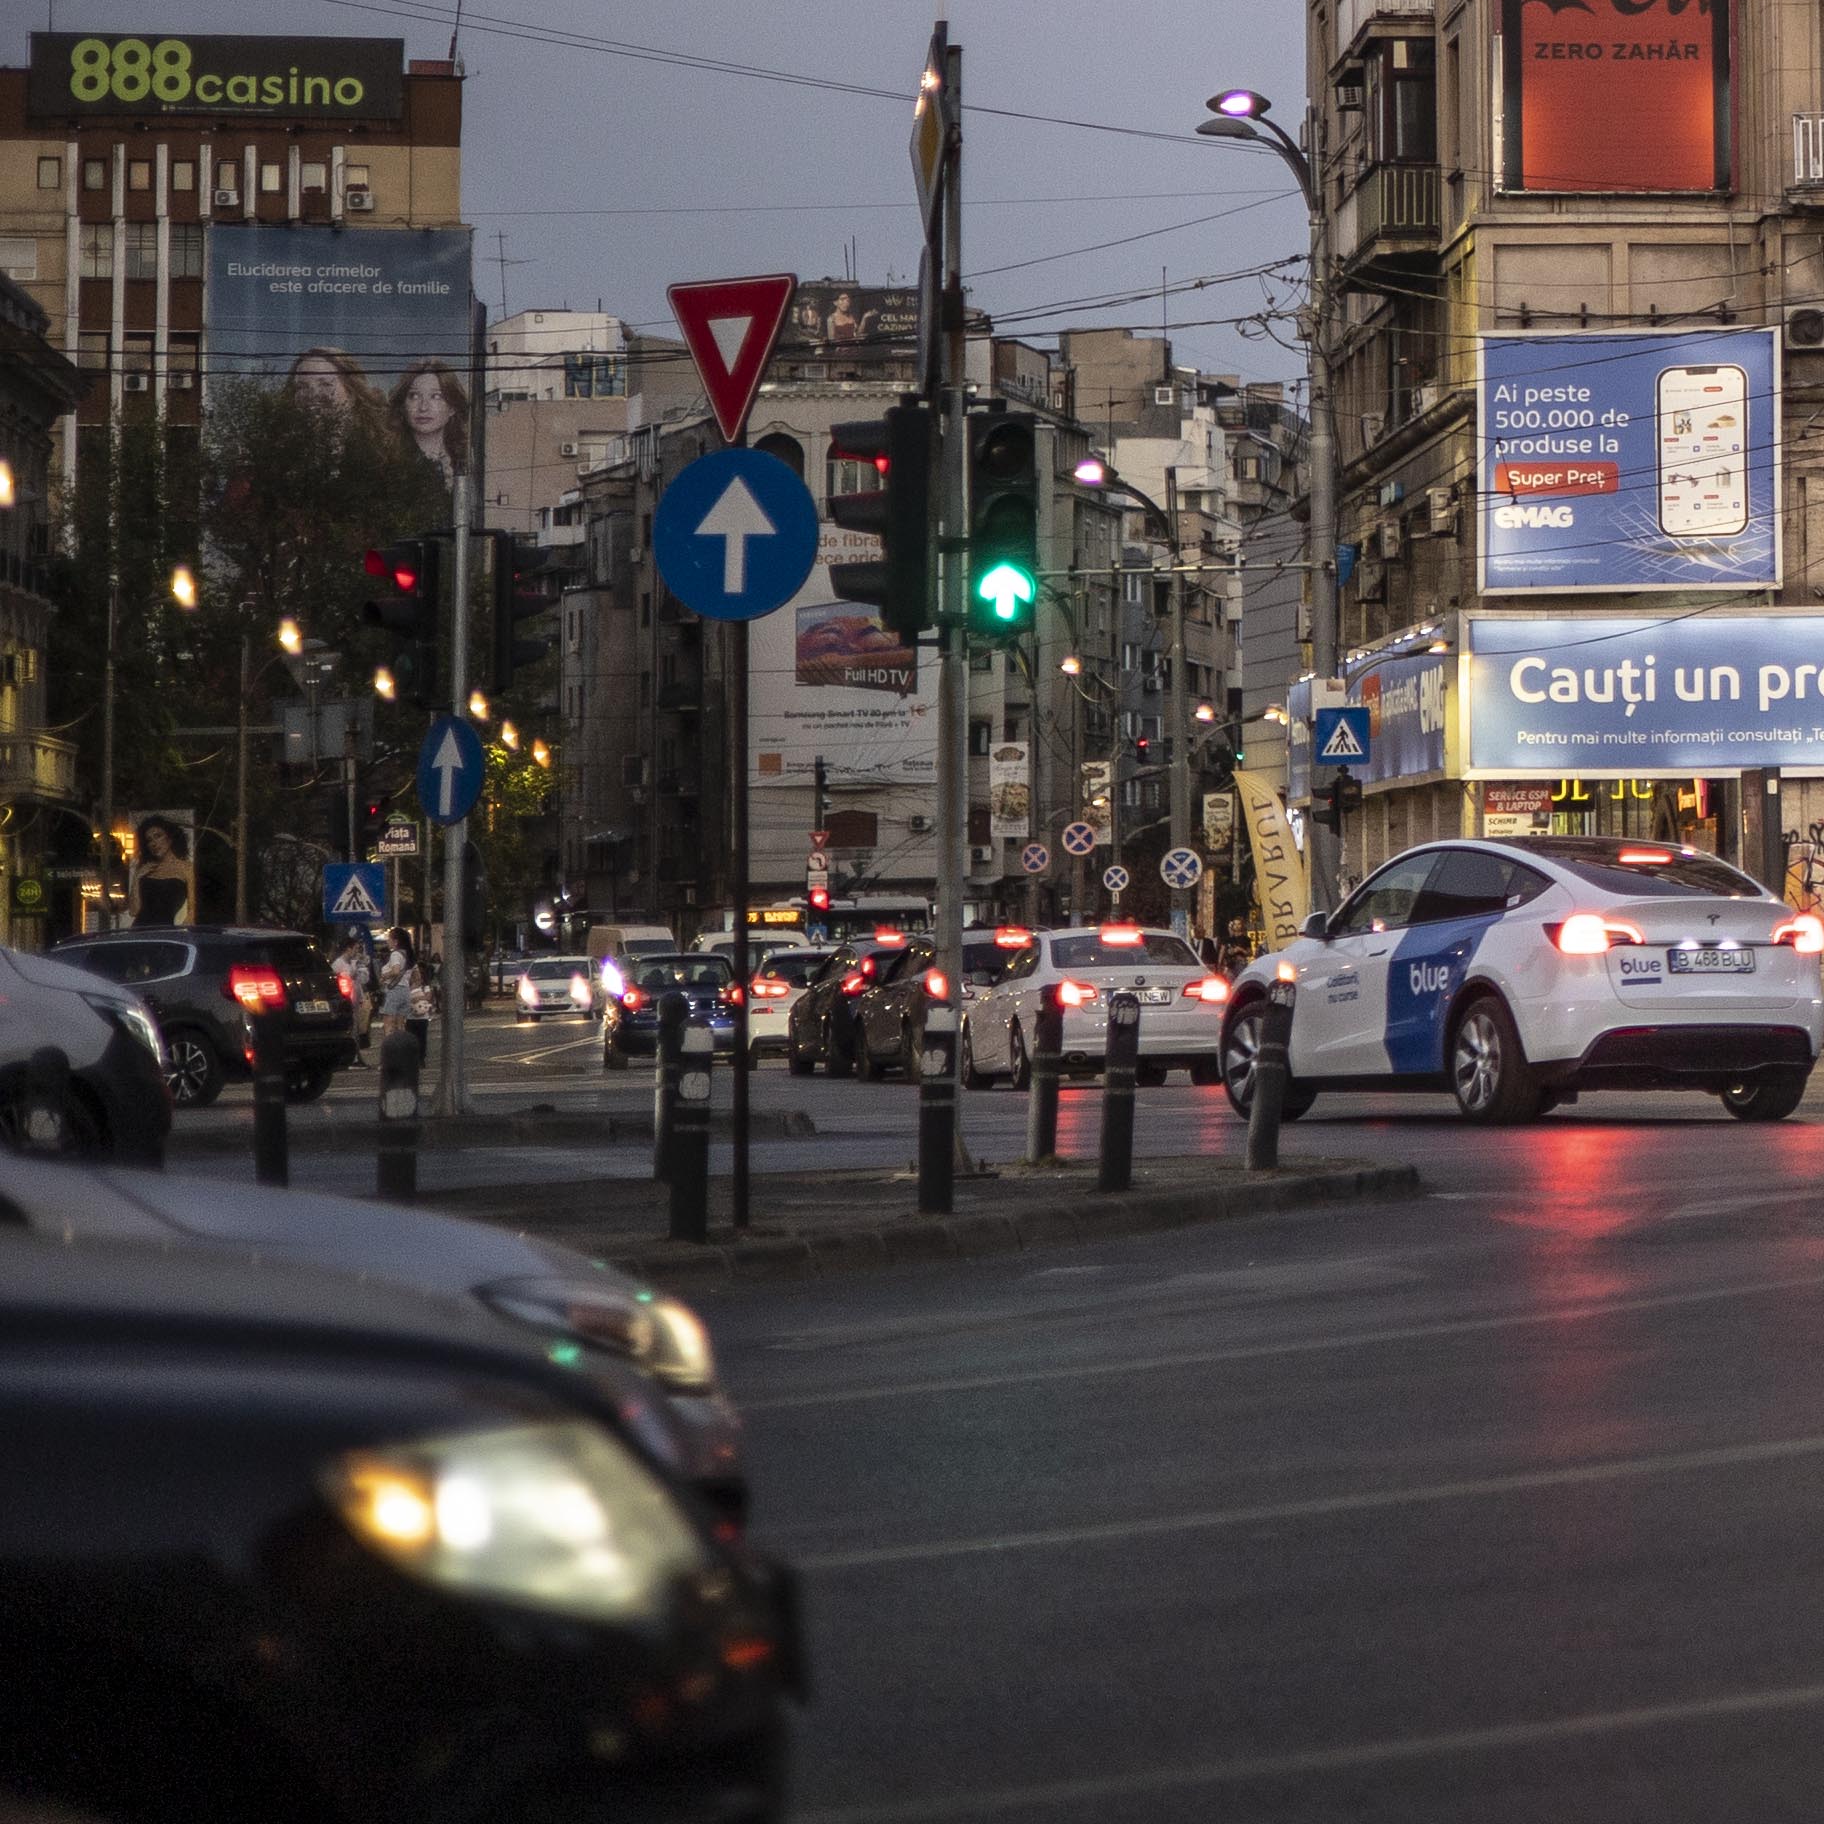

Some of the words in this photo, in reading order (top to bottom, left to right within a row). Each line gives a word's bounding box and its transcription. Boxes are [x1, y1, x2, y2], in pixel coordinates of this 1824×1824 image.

[1534, 43, 1603, 60] ZERO
[1611, 37, 1700, 61] ZAHĂR
[227, 262, 312, 278] Elucidarea
[316, 262, 381, 278] crimelor
[269, 280, 303, 295] este
[307, 278, 368, 295] afacere
[372, 279, 394, 295] de
[397, 279, 450, 296] familie
[1494, 384, 1518, 403] Ai
[1525, 384, 1591, 406] peste
[1495, 410, 1595, 429] 500.000
[1600, 408, 1630, 428] de
[1494, 435, 1593, 460] produse
[1599, 435, 1620, 454] la
[1508, 469, 1563, 488] Super
[1567, 469, 1606, 488] Preț
[844, 667, 867, 682] Full
[870, 669, 888, 684] HD
[890, 669, 909, 686] TV
[1509, 654, 1655, 717] Cauți
[1674, 660, 1740, 702] un
[1517, 729, 1568, 746] Pentru
[1570, 730, 1600, 745] mai
[1602, 728, 1647, 745] multe
[1650, 727, 1724, 747] informații
[1727, 726, 1803, 746] consultați
[1505, 800, 1542, 812] LAPTOP
[1620, 958, 1662, 974] blue
[1678, 951, 1690, 967] B
[1694, 951, 1720, 967] 468
[1721, 950, 1752, 967] BLU
[1409, 961, 1450, 995] blue
